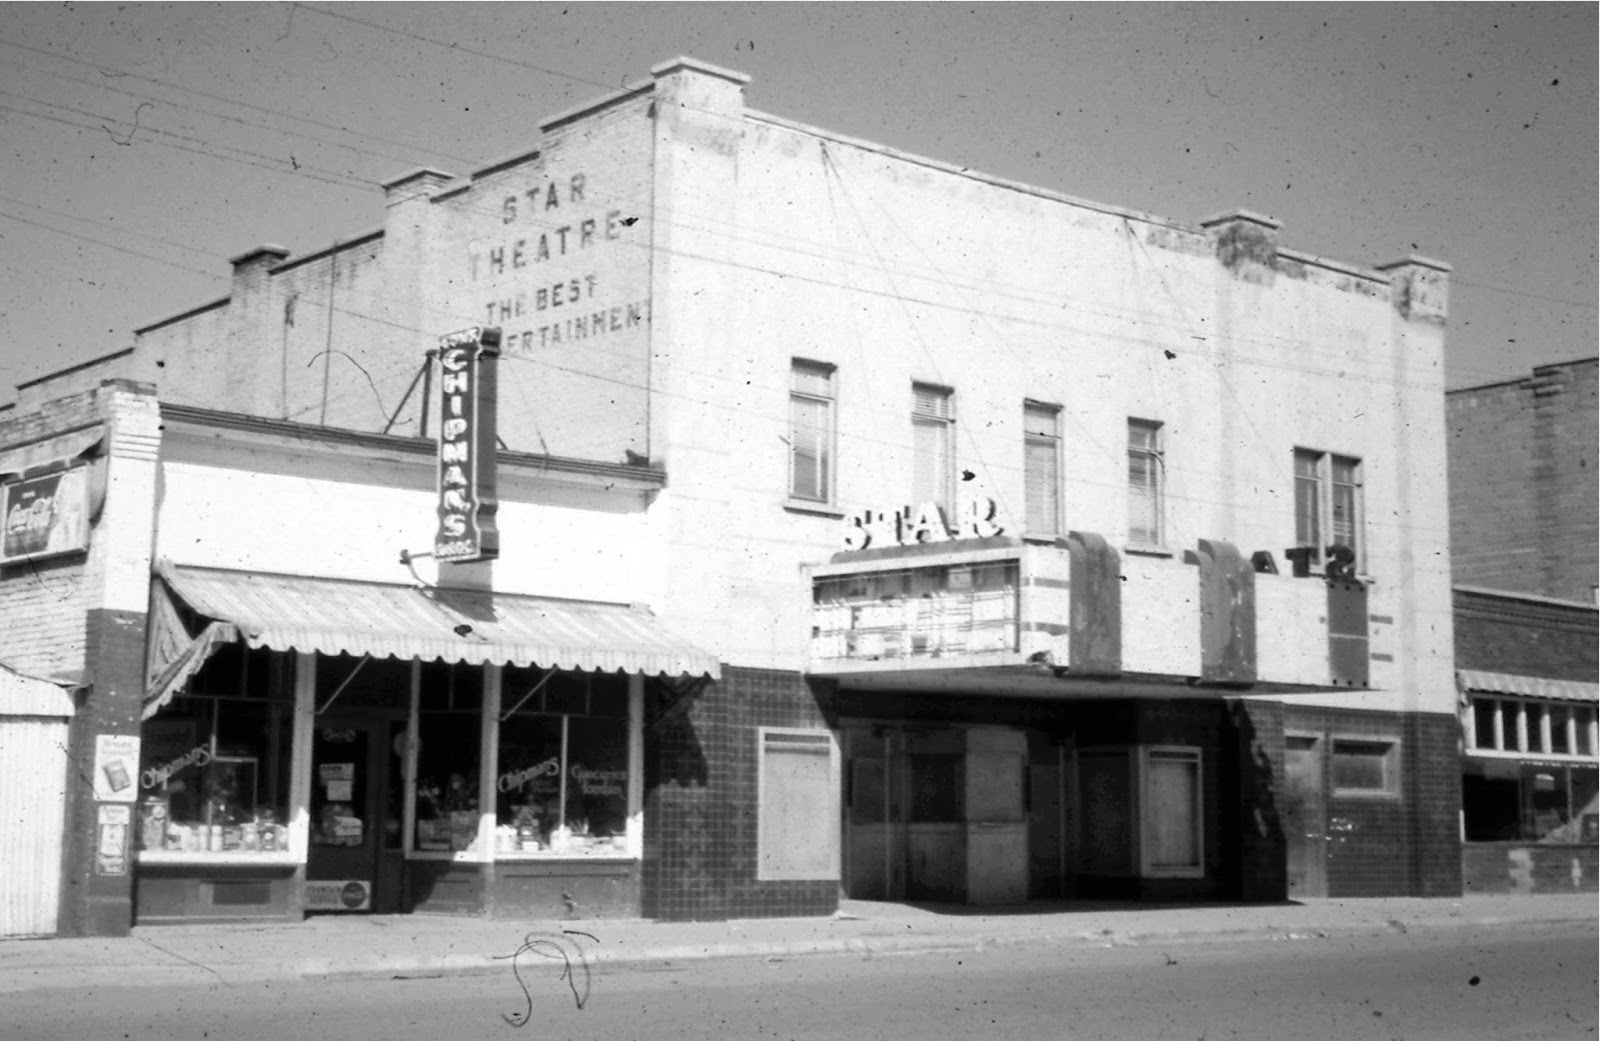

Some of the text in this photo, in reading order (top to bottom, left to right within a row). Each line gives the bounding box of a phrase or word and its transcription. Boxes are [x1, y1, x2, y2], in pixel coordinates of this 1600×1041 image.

[503, 172, 586, 225] STAR
[468, 210, 621, 281] THEATRE
[536, 274, 597, 312] BEST
[843, 496, 1004, 551] STAR
